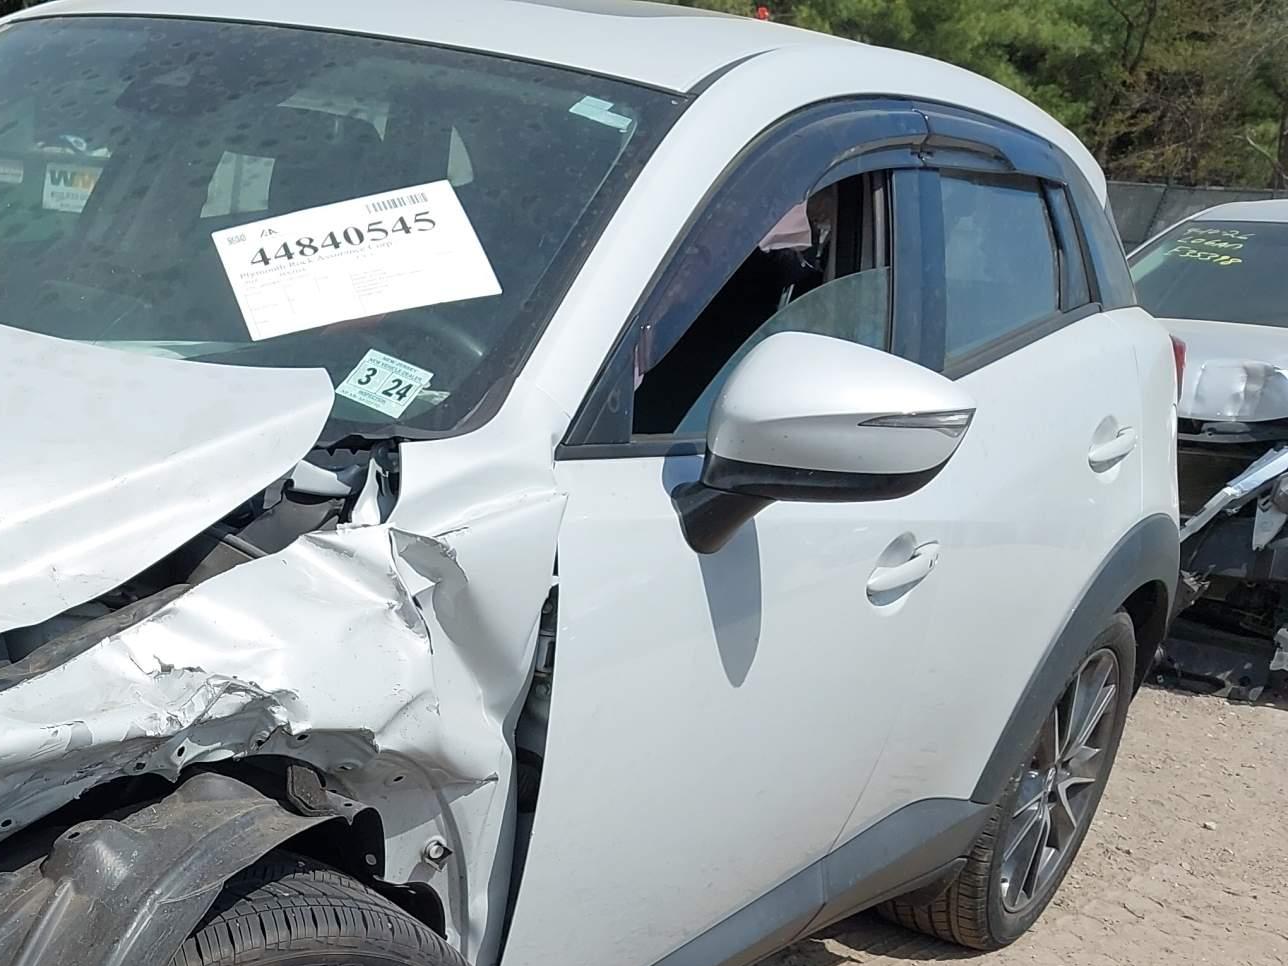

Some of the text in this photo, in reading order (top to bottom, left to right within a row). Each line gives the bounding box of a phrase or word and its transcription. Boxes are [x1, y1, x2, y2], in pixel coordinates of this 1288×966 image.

[250, 210, 436, 266] 44840545
[358, 367, 377, 385] 3
[381, 378, 414, 401] 24
